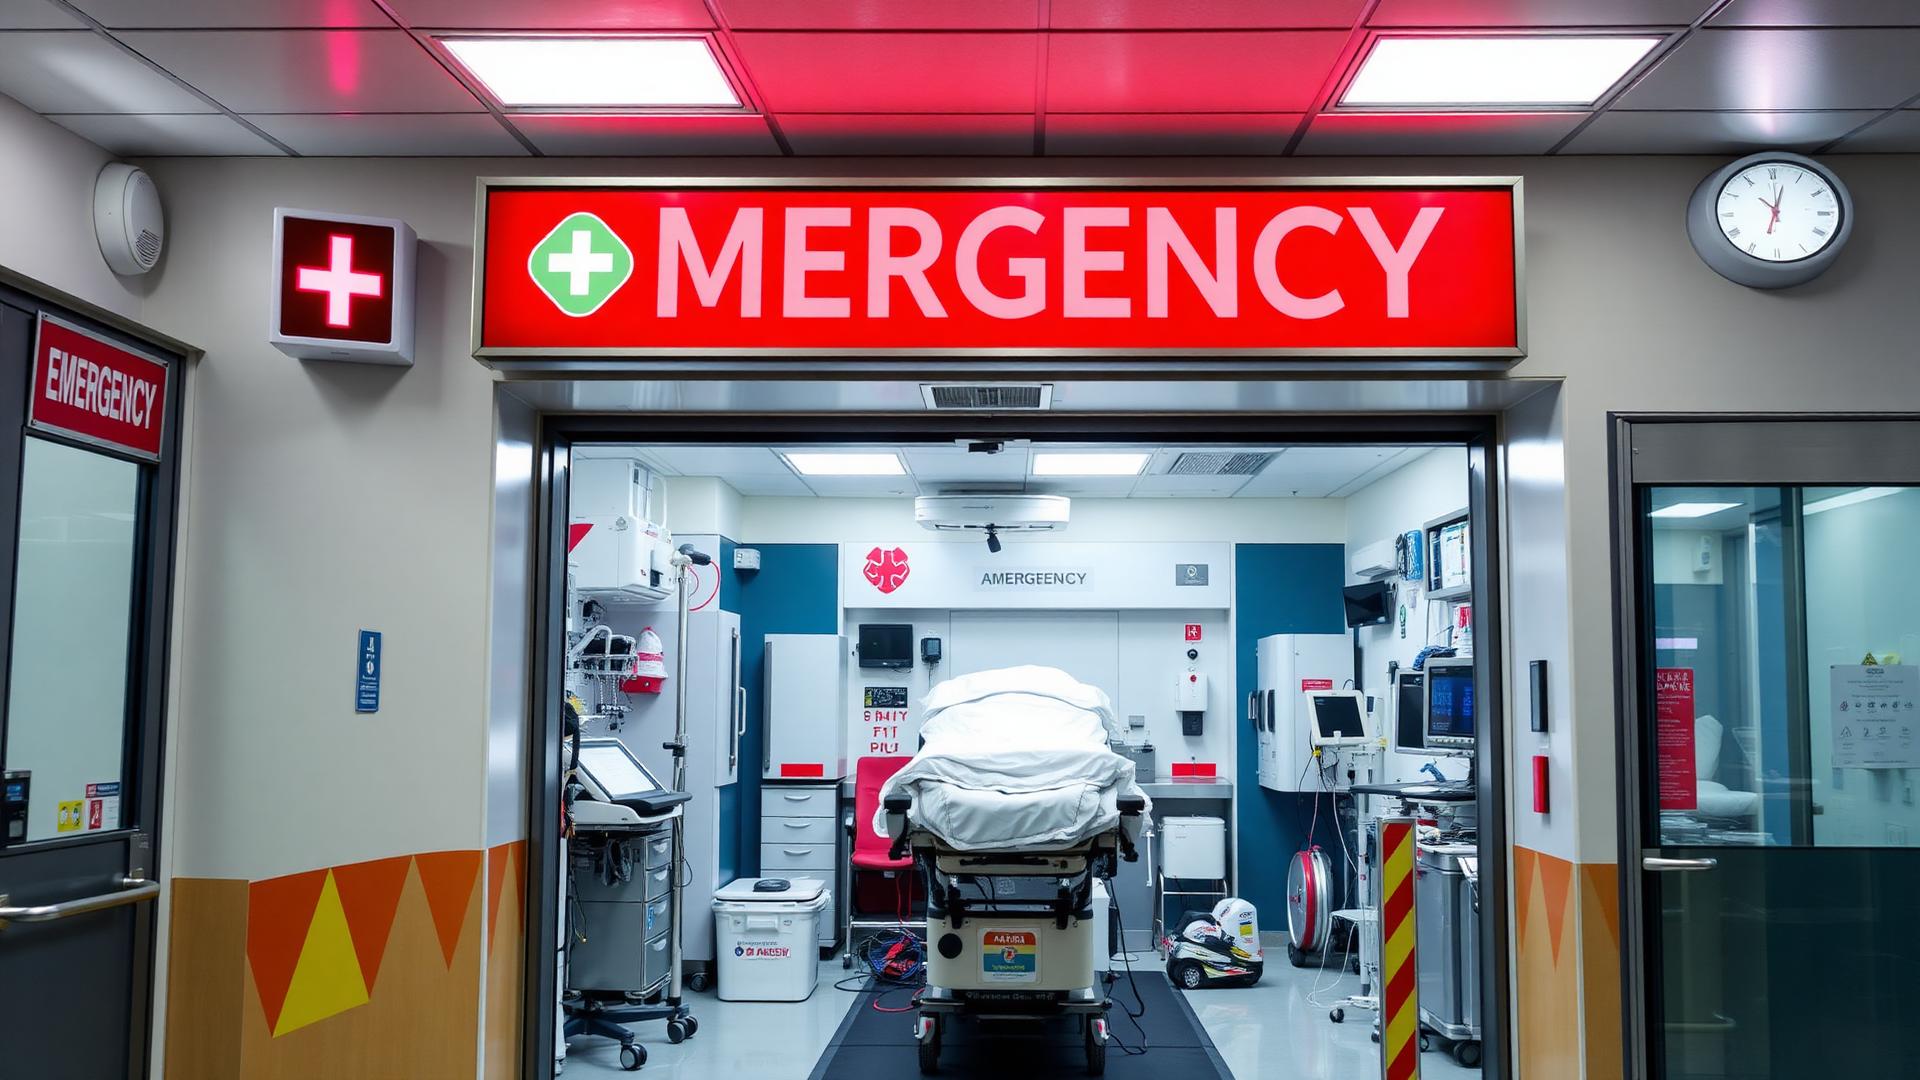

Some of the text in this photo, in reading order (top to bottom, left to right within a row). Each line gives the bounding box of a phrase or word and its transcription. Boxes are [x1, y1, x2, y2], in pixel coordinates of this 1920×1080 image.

[656, 205, 1445, 320] MERGENCY
[45, 346, 158, 430] EMERGENCY
[981, 572, 1087, 585] AMERGEENCY
